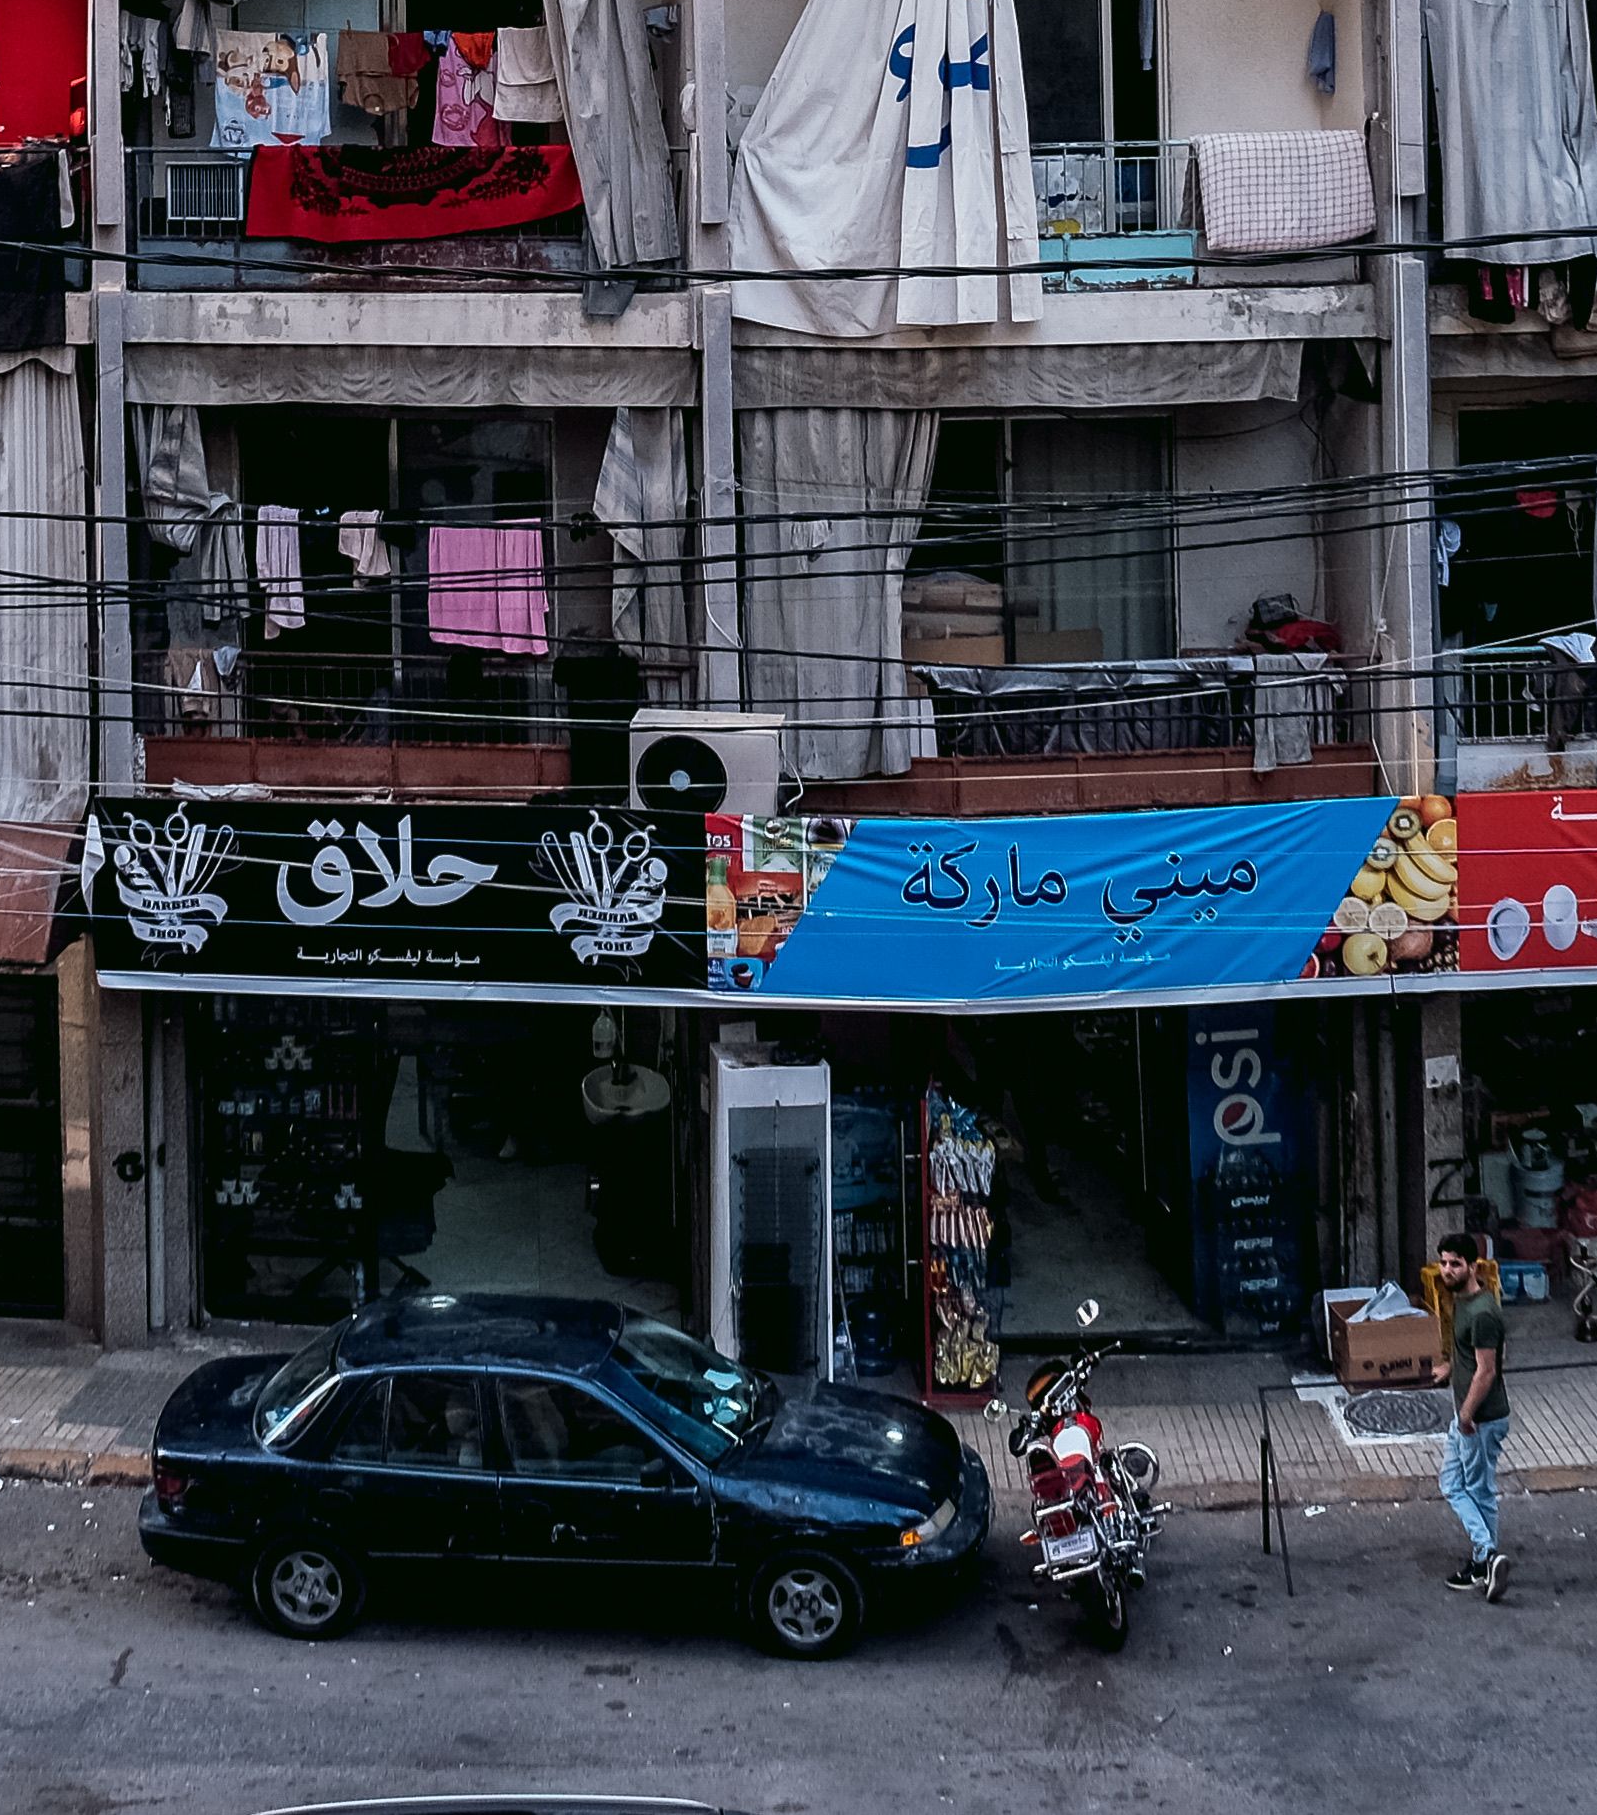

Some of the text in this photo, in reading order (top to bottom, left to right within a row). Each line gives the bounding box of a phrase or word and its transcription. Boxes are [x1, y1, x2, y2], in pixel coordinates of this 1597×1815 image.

[276, 813, 500, 926] حلاق
[900, 840, 1259, 945] ميني ماركة
[141, 897, 201, 912] BARBER
[148, 928, 187, 940] SHOP
[425, 948, 481, 968] مؤسسة
[1234, 1236, 1273, 1252] PEPSI
